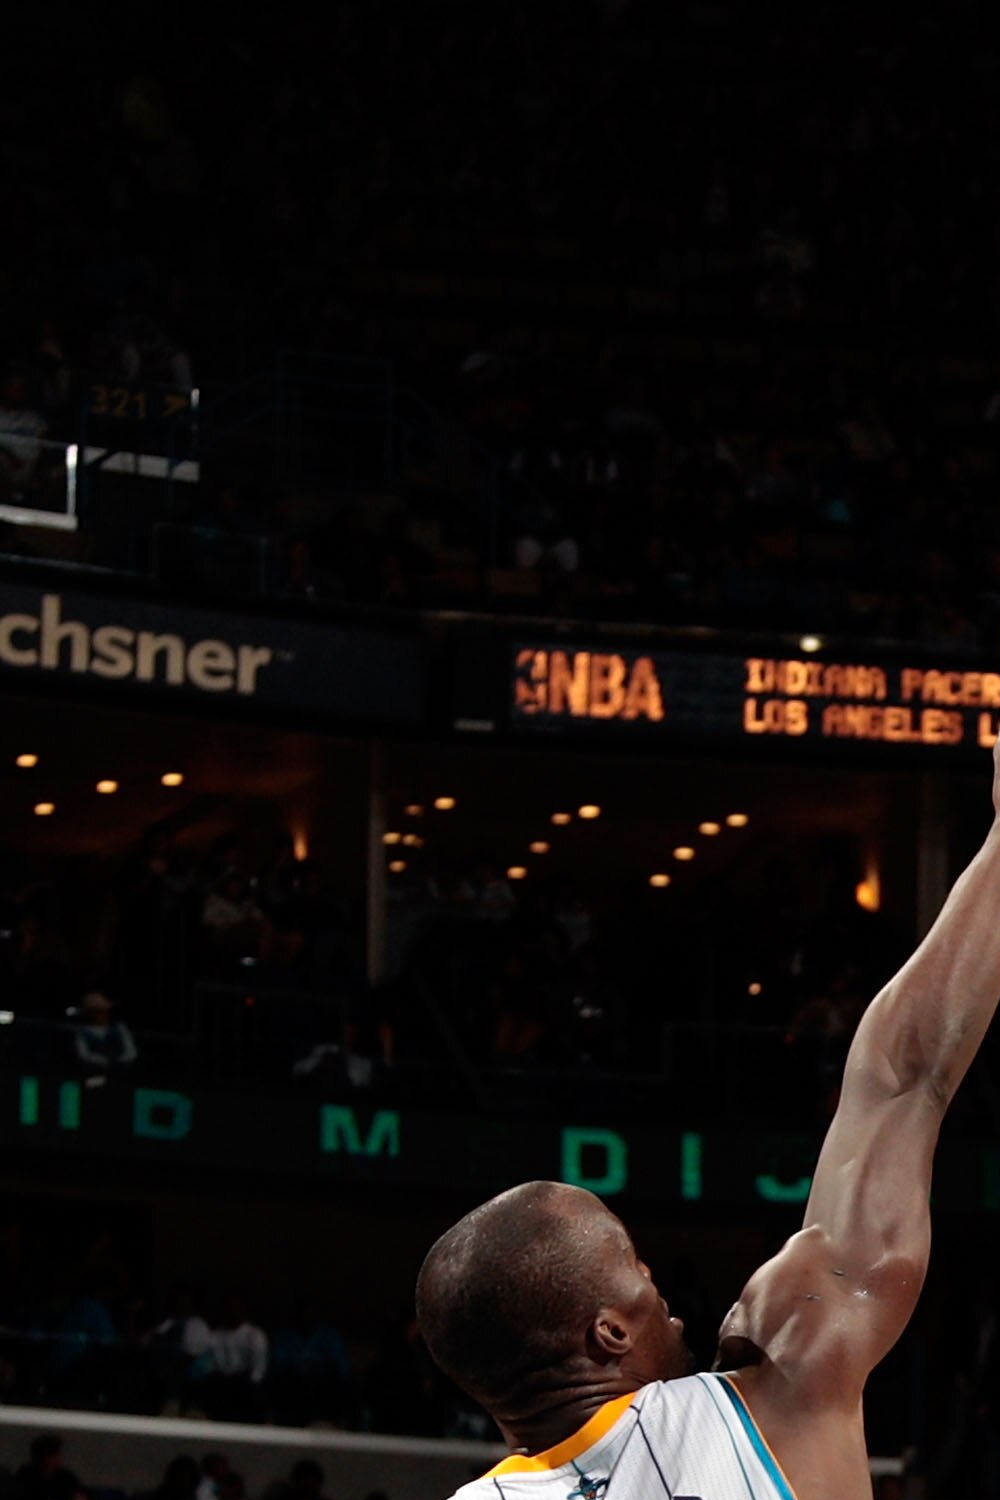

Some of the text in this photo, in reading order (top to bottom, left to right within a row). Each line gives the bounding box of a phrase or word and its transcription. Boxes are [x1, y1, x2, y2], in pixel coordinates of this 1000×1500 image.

[0, 593, 272, 694] chsner
[549, 650, 664, 722] NBA
[745, 659, 887, 699] INDIANA
[744, 698, 808, 735] LOS
[823, 705, 964, 744] ANGELES
